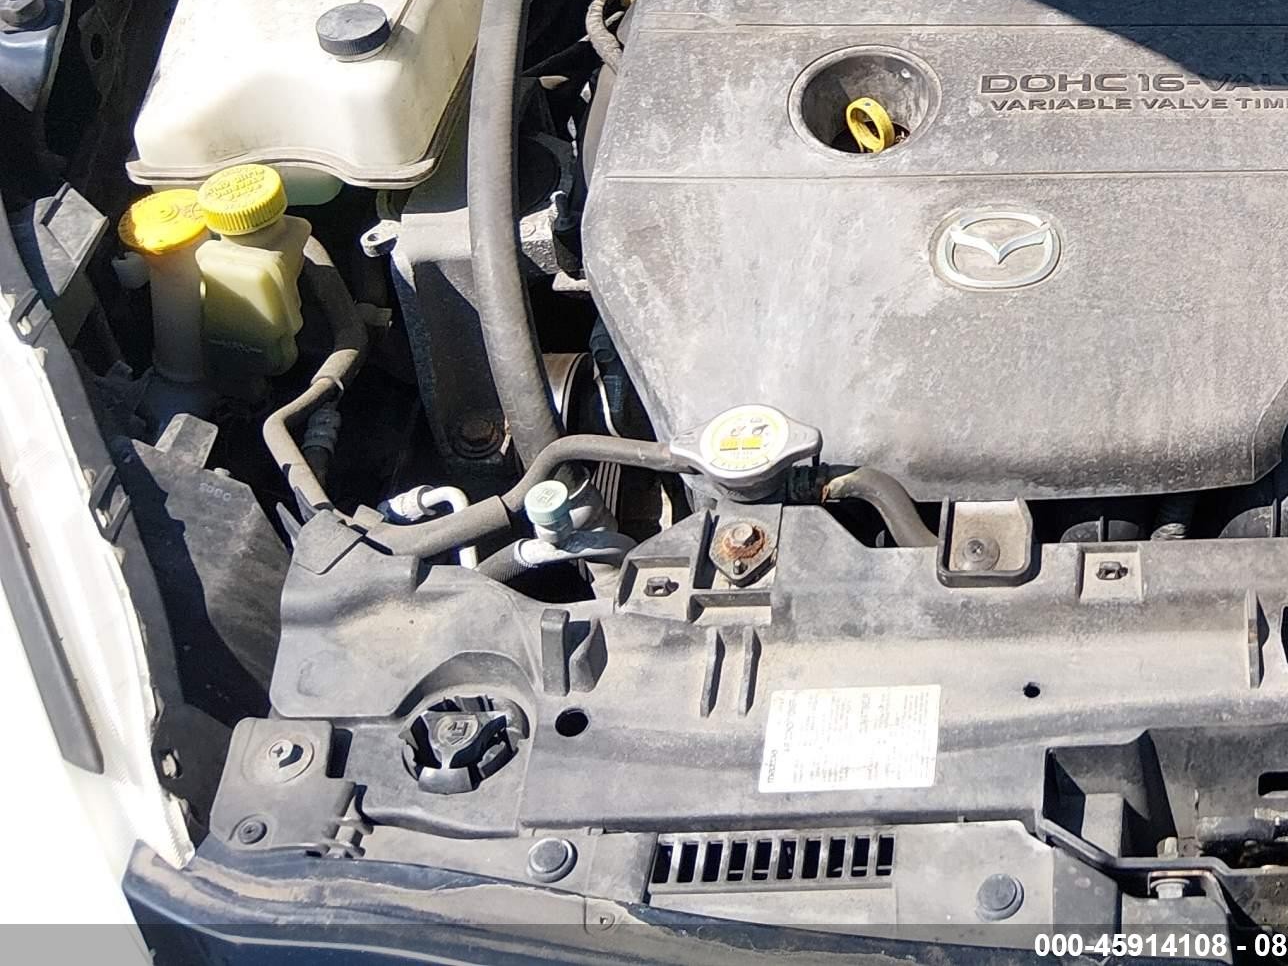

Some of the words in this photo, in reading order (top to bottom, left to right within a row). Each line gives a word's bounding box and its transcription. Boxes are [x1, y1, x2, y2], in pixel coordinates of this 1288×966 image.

[980, 73, 1128, 94] DOHC
[990, 97, 1133, 111] VARIABLE
[1141, 97, 1230, 110] VALVE
